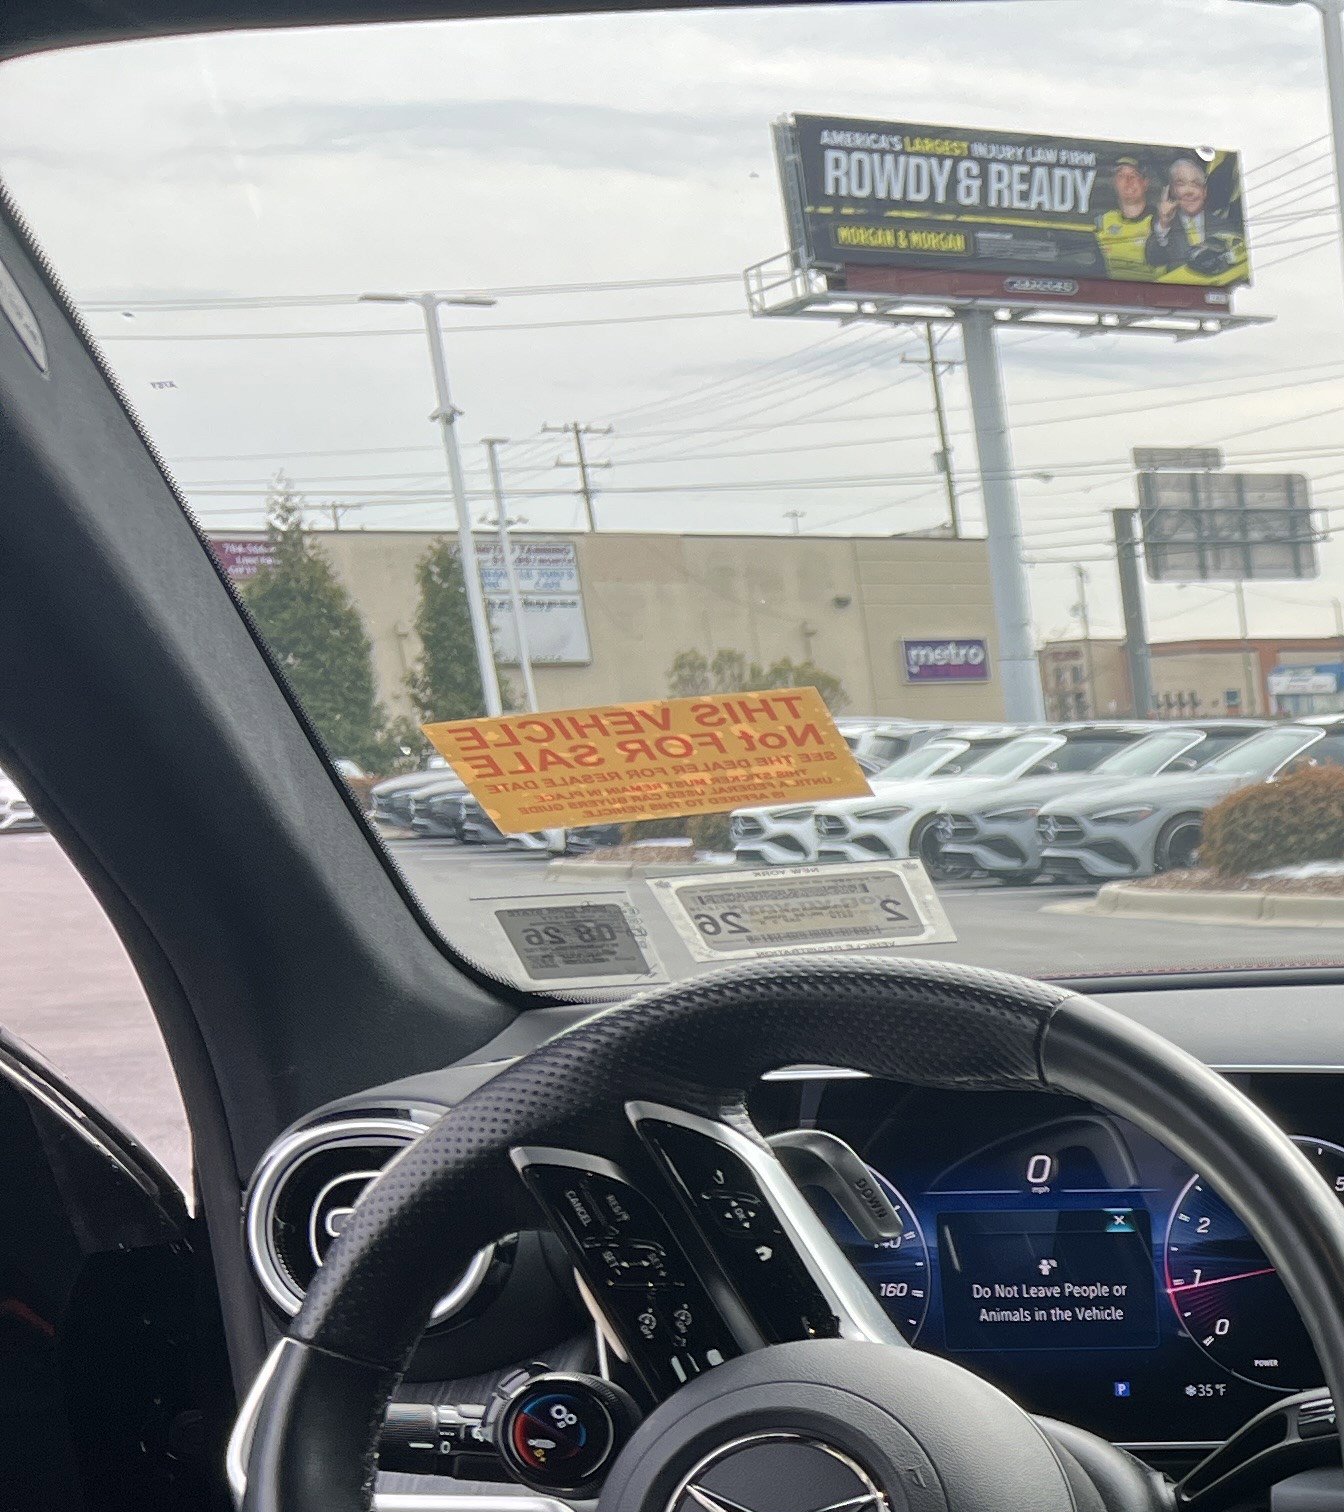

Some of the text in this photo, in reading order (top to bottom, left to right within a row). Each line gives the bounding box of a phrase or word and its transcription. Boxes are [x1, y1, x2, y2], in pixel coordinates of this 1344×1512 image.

[820, 129, 901, 151] AMERICA'S
[904, 136, 969, 156] LARGEST
[970, 142, 1024, 162] INJURY
[1026, 147, 1058, 165] LAW
[824, 149, 1098, 214] ROWDY & READY
[837, 225, 897, 247] MORGAN
[898, 230, 908, 248] &
[909, 230, 966, 251] MORGAN
[909, 641, 985, 670] metro
[1026, 1154, 1052, 1183] 0
[854, 1177, 888, 1219] DOWN
[565, 1190, 592, 1227] CANCEL
[1197, 1217, 1211, 1232] 2
[1192, 1270, 1202, 1286] 1
[879, 1282, 908, 1297] 160
[972, 1283, 1128, 1300] Do Not Leave People or
[979, 1306, 1124, 1323] Animals in the Vehicle
[1216, 1318, 1230, 1335] 0
[1254, 1359, 1279, 1367] POWER
[1117, 1383, 1127, 1395] P
[1197, 1384, 1213, 1397] 35
